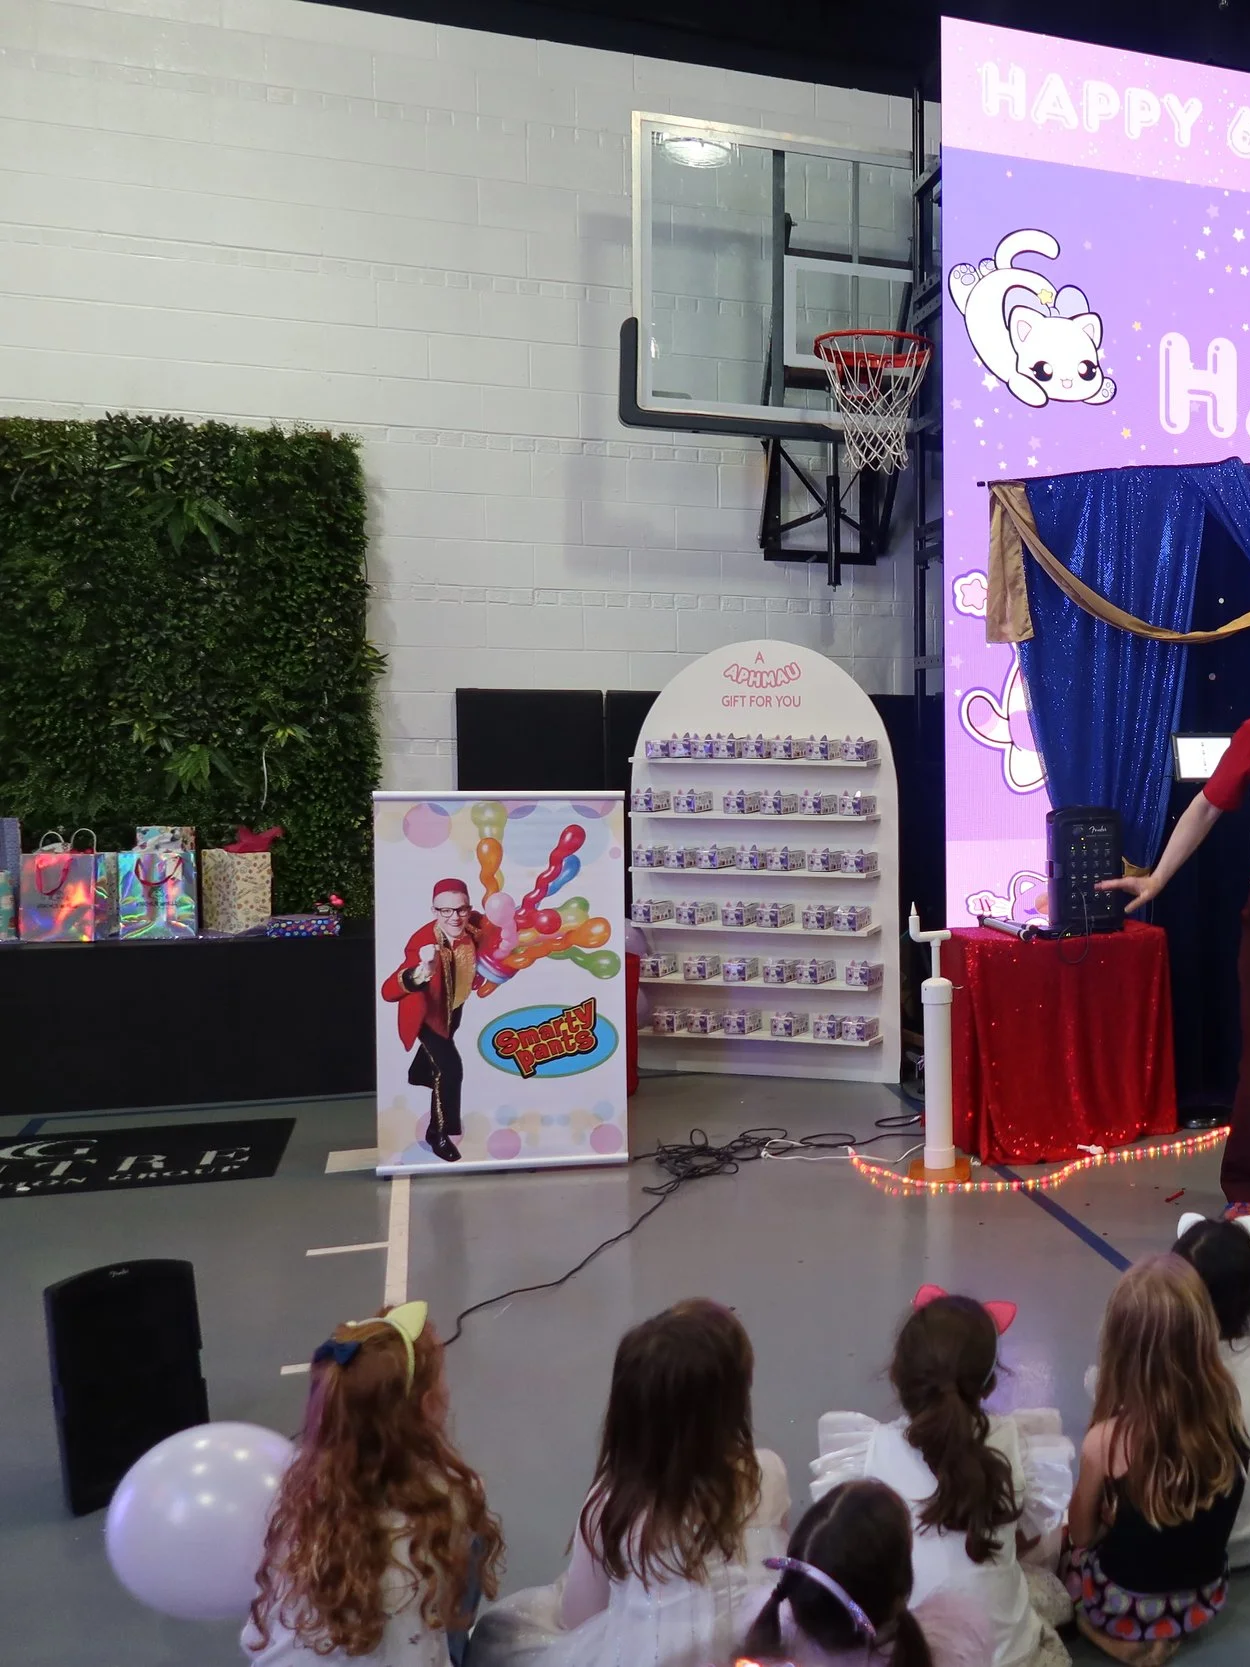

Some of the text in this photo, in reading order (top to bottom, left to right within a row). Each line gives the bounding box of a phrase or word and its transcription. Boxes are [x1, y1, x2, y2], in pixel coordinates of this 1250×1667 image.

[981, 61, 1202, 148] HAPPY
[723, 661, 801, 689] APHMAU
[754, 651, 765, 664] A
[721, 695, 802, 708] GIFT FOR YOU
[494, 998, 596, 1056] Smarty
[513, 1029, 596, 1075] pants
